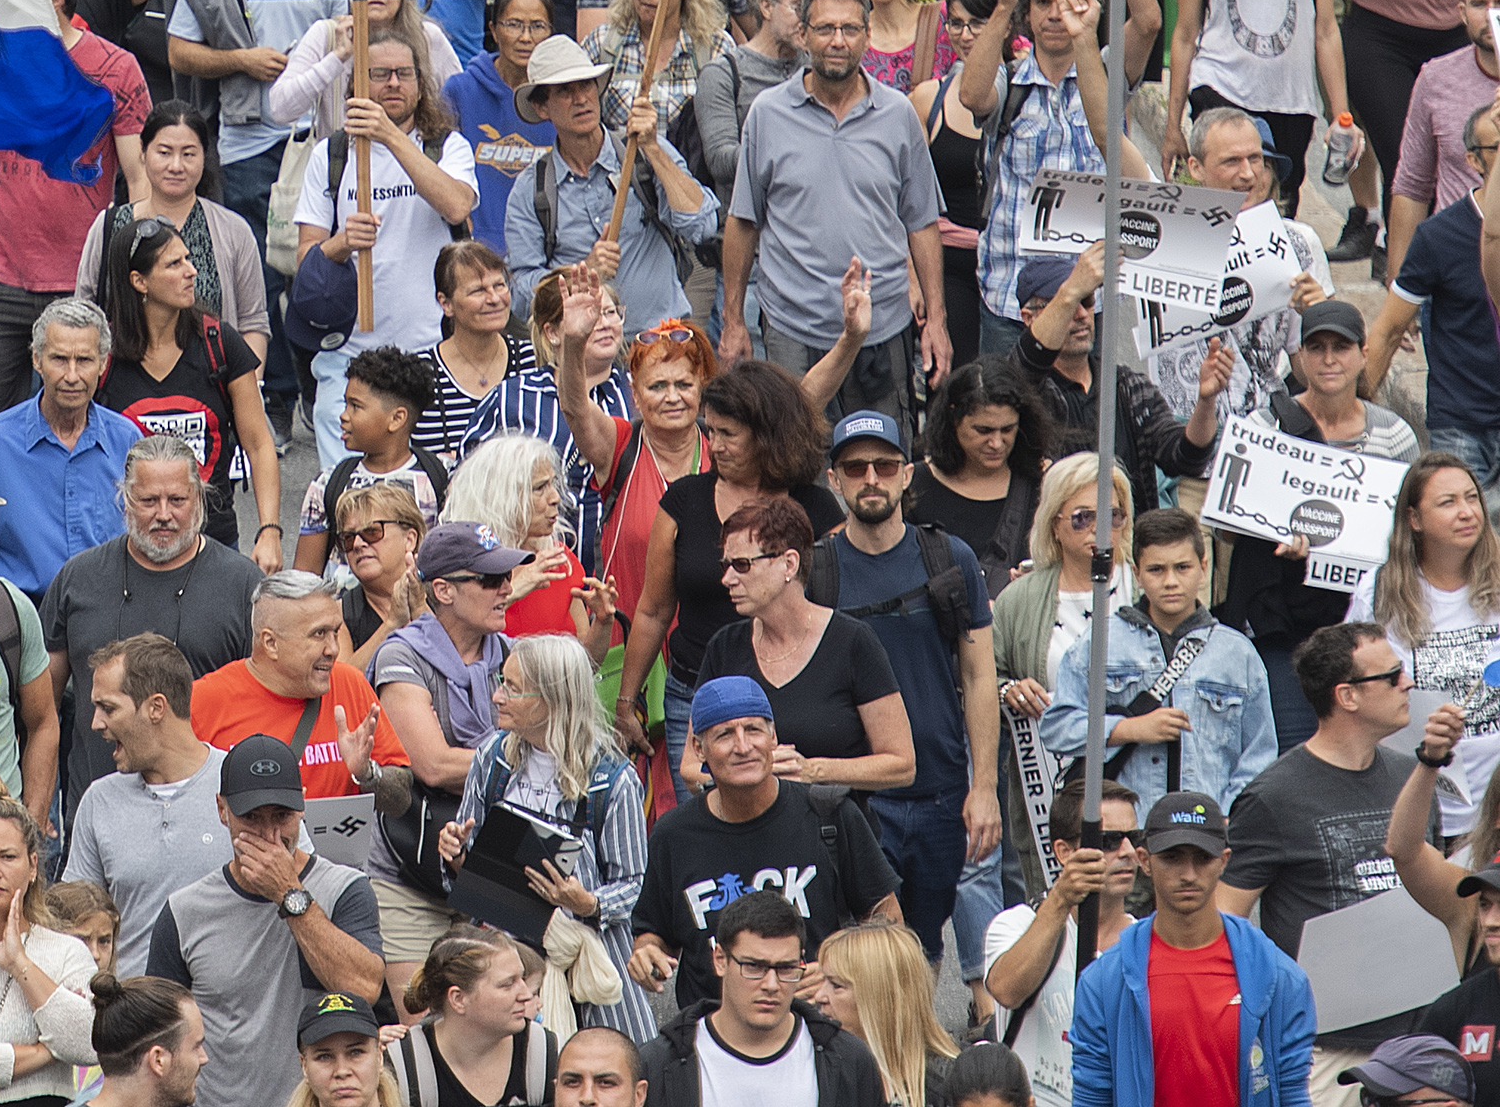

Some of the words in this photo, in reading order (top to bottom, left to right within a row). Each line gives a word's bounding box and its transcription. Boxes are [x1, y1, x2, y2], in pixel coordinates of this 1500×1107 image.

[1042, 169, 1130, 190] trudeu
[1097, 192, 1176, 217] lgault
[1120, 231, 1159, 250] SSPORT
[1133, 272, 1218, 308] LIBERTÉ
[1221, 282, 1249, 302] ACCINE
[1230, 424, 1317, 464] trudeau
[1281, 468, 1361, 503] legault
[1300, 504, 1341, 525] VACCINE
[1291, 519, 1340, 540] PASSPORT
[1312, 561, 1366, 586] LIBE
[304, 741, 343, 766] BATTL
[684, 864, 817, 930] FCK
